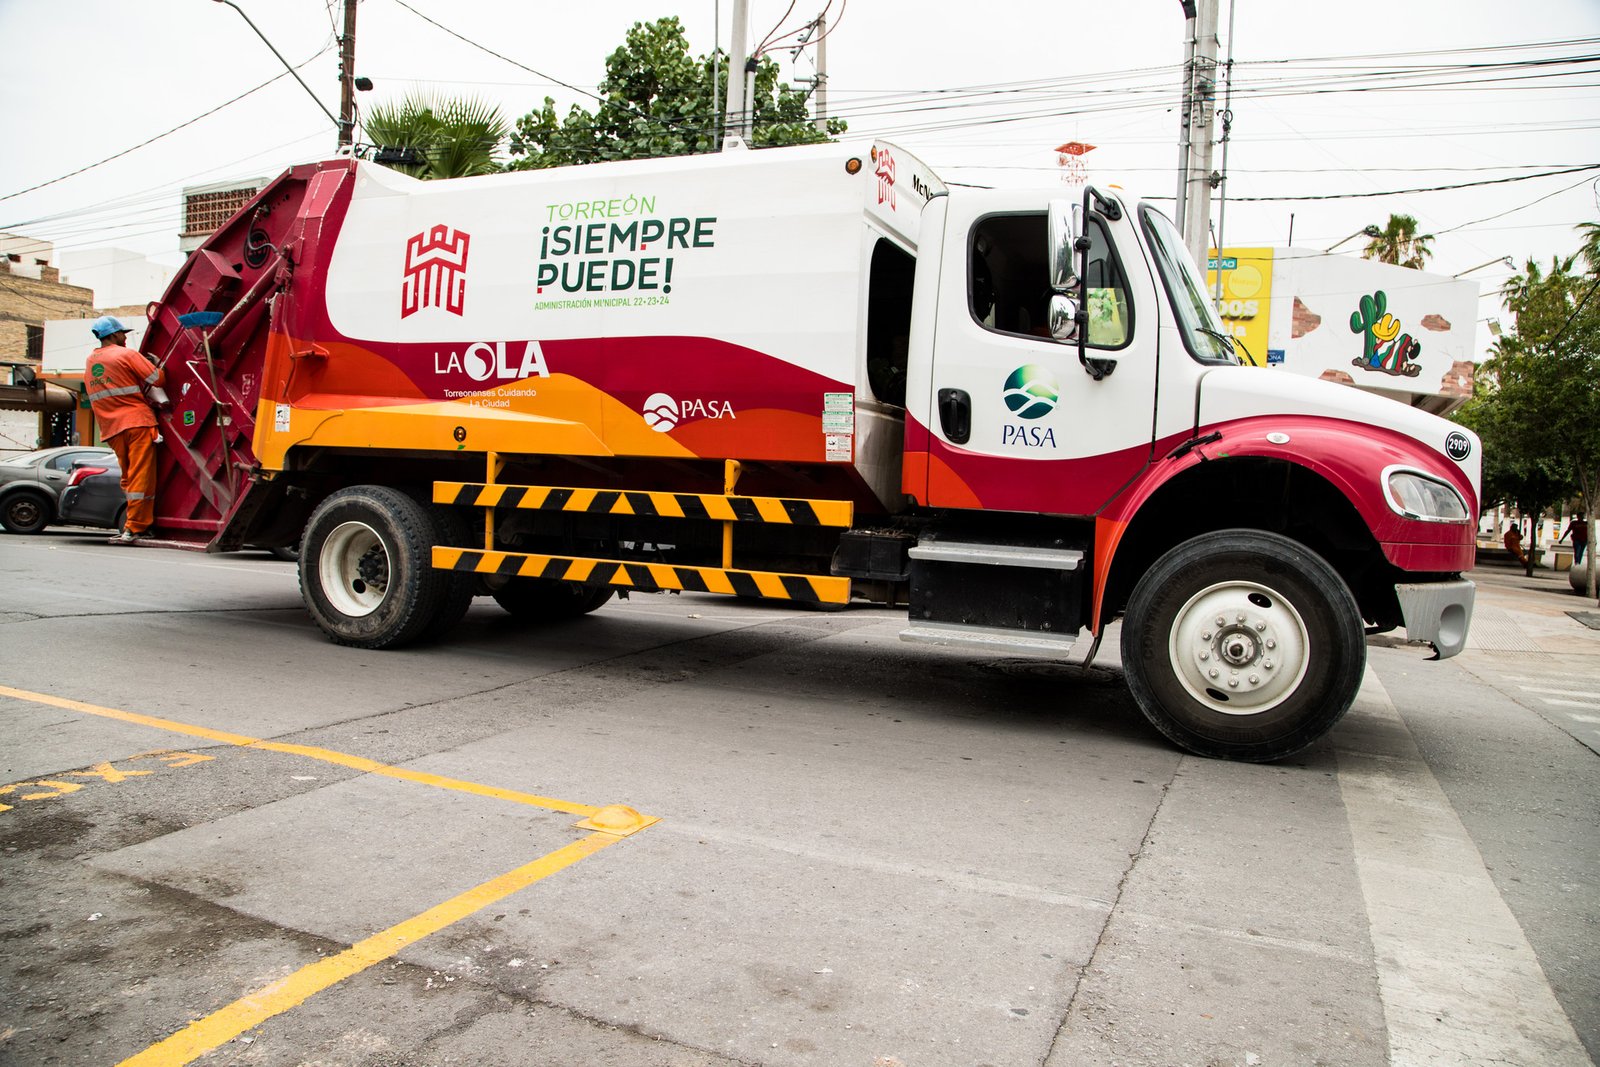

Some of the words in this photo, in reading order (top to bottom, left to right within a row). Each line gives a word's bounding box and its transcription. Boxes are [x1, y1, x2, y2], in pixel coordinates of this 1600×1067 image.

[546, 193, 656, 223] TORREÓN
[540, 217, 717, 260] ¡SIEMPRE
[537, 257, 674, 294] PUEDE!
[534, 298, 592, 311] ADMINISTRACIÓN
[593, 298, 631, 308] MUNICIPAL
[434, 351, 463, 374] LA
[463, 340, 550, 382] OLA
[443, 389, 496, 398] Torreonenses
[497, 388, 537, 397] Cuidando
[469, 400, 481, 408] La
[481, 399, 510, 408] Ciudad
[681, 398, 736, 419] PASA
[1002, 424, 1057, 448] PASA
[1449, 438, 1468, 451] 2909
